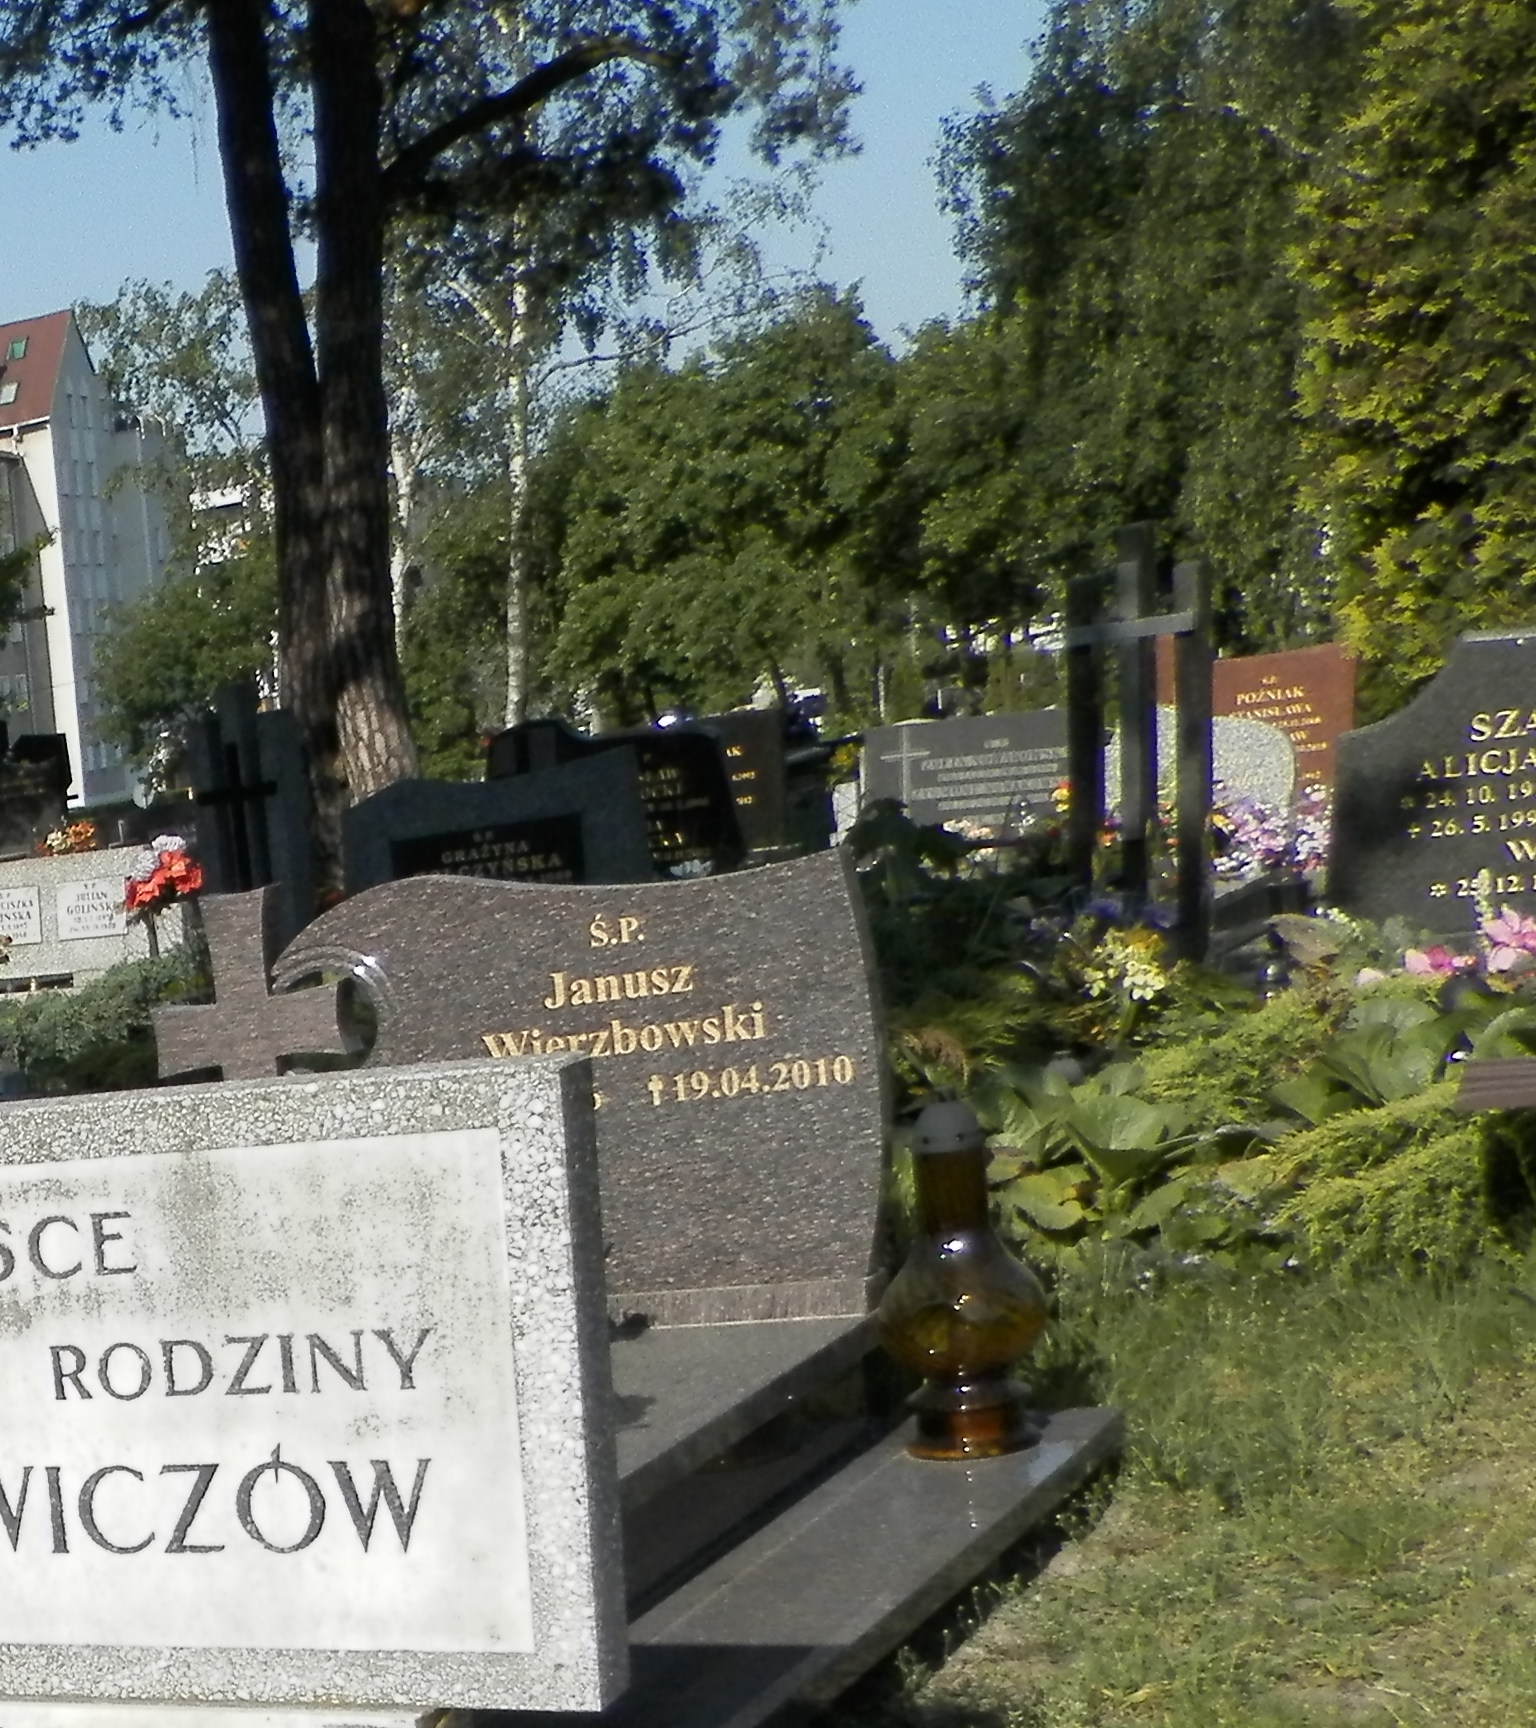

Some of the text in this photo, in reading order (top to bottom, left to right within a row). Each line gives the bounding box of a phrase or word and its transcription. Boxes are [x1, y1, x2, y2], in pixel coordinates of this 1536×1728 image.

[1506, 779, 1536, 801] 19
[589, 912, 645, 948] Ś.P.
[543, 962, 695, 1010] Janusz
[481, 1000, 767, 1059] Wierzbowski
[672, 1054, 855, 1102] 19.04.2010
[49, 1328, 431, 1402] RODZINY
